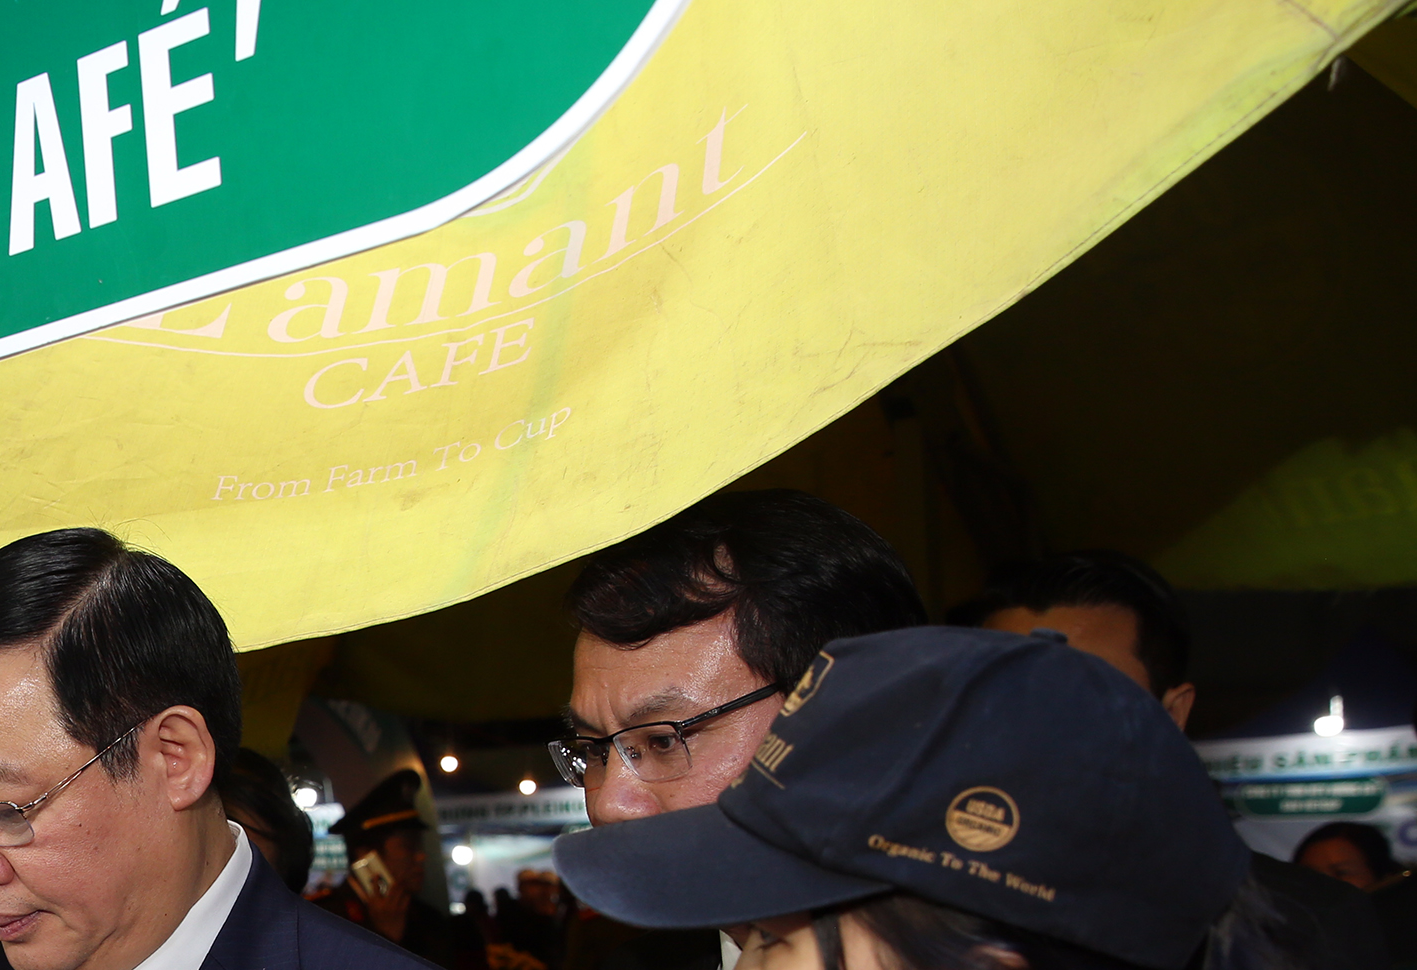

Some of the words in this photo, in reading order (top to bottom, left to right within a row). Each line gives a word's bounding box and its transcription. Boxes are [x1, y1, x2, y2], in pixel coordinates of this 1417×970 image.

[304, 318, 534, 409] CAFE
[212, 475, 311, 501] From
[324, 459, 417, 493] Farm
[434, 442, 482, 471] To
[493, 406, 572, 450] Cup
[868, 834, 936, 863] Organic
[940, 852, 964, 870] To
[968, 860, 1001, 883] The
[1005, 873, 1056, 902] World
